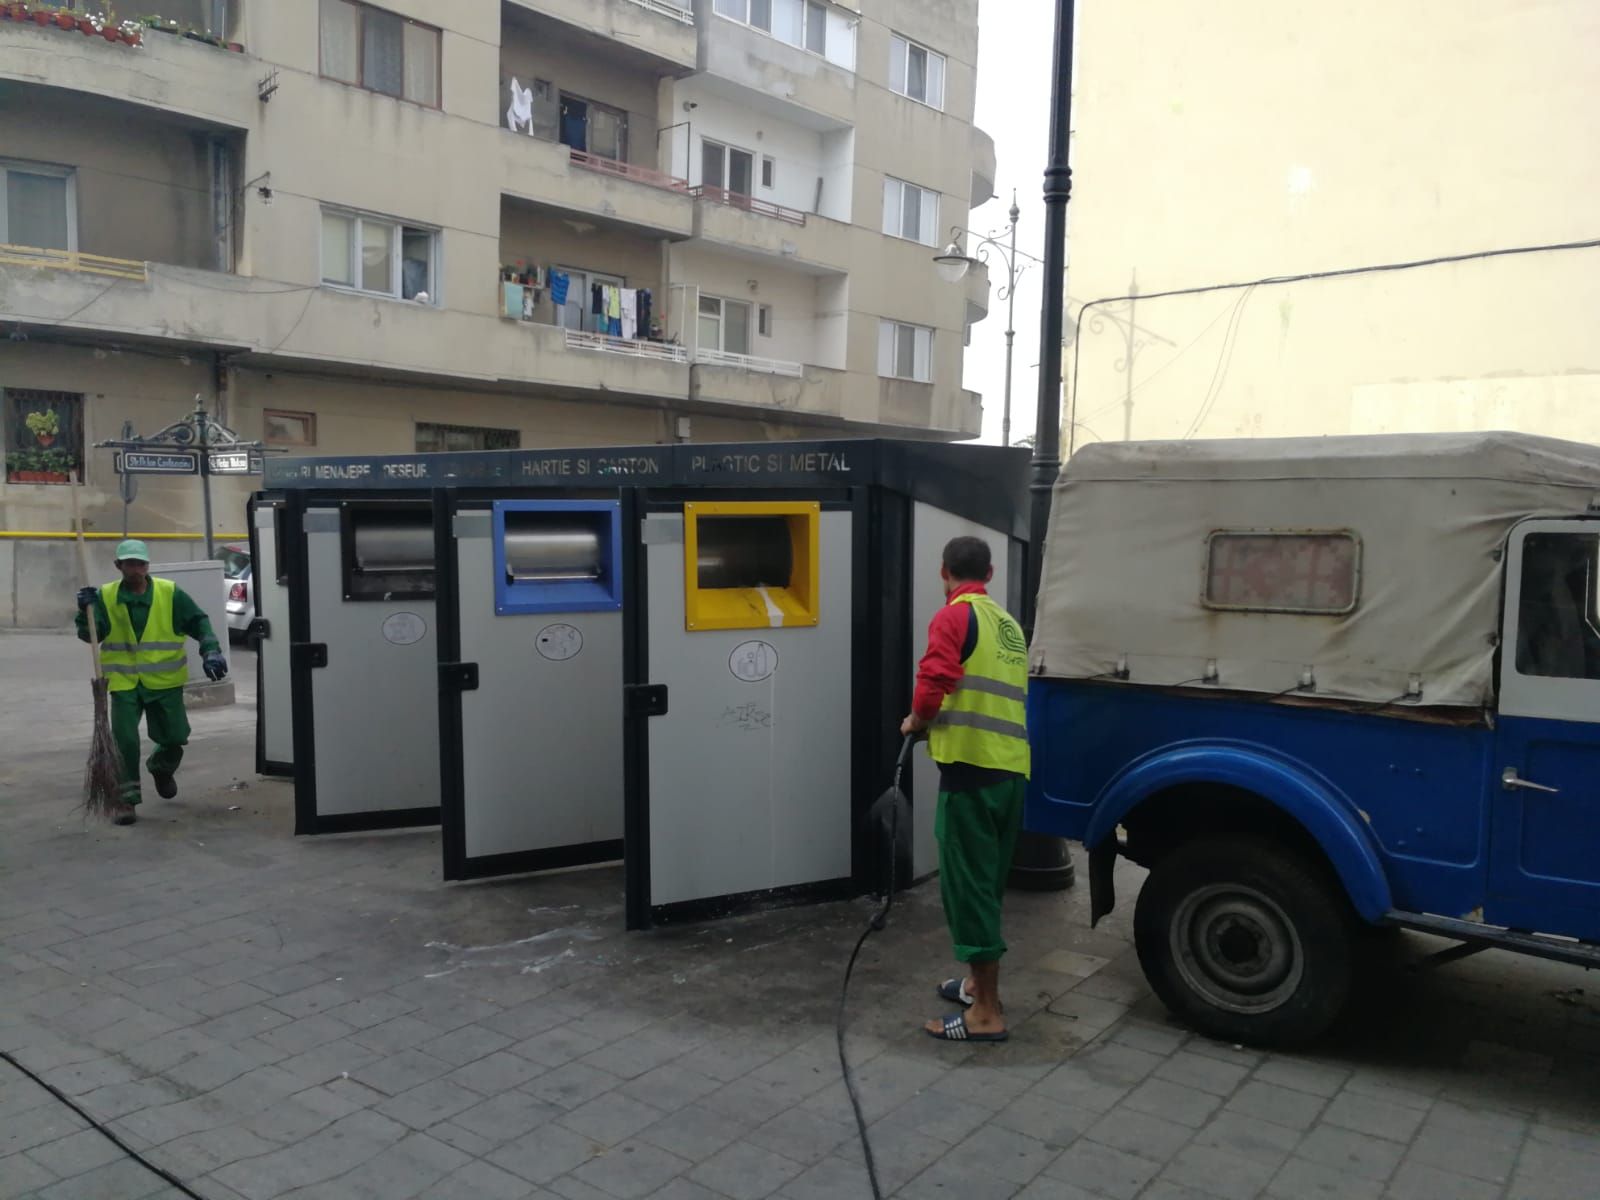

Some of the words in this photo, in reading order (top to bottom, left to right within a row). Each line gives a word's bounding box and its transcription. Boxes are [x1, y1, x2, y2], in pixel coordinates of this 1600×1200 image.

[521, 459, 571, 476] HARTIE
[577, 458, 590, 475] SI
[767, 454, 782, 472] SI
[790, 452, 851, 472] METAL
